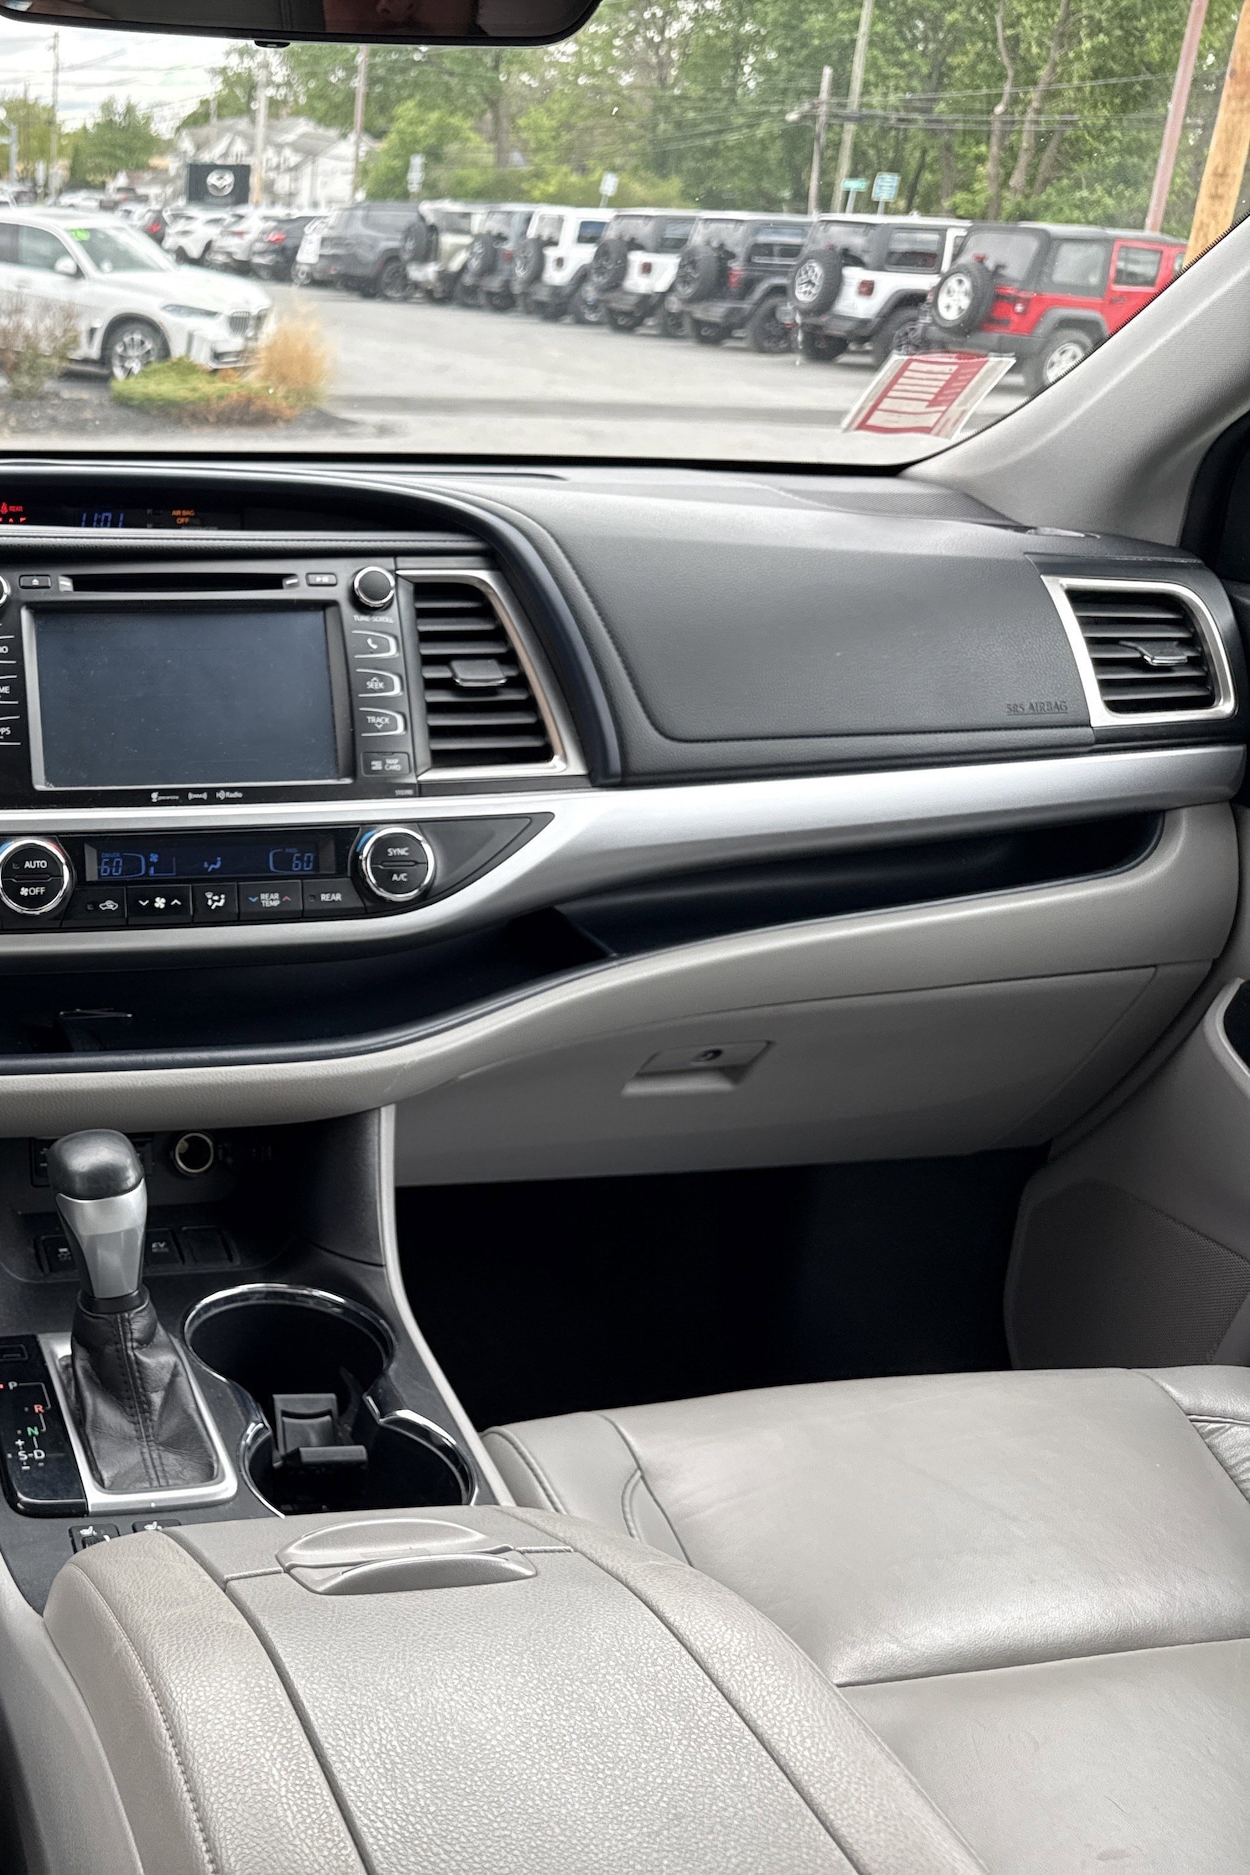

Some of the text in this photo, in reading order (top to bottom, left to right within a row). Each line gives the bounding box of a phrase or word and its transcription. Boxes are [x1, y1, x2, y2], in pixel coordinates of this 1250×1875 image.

[176, 517, 190, 525] OFF
[1006, 701, 1068, 714] SRS AIRBAG
[366, 716, 390, 725] TRACK
[226, 790, 243, 798] Radio
[388, 848, 409, 856] SYNC
[24, 860, 48, 869] AUTO
[292, 853, 314, 870] 60
[100, 858, 123, 876] 60
[392, 873, 408, 882] A/C
[28, 887, 46, 896] OFF
[260, 892, 280, 900] REAR
[320, 892, 342, 902] REAR
[261, 900, 280, 908] TEMP
[8, 1382, 18, 1391] P
[34, 1404, 45, 1414] R
[26, 1426, 40, 1436] N
[18, 1449, 46, 1460] S D
